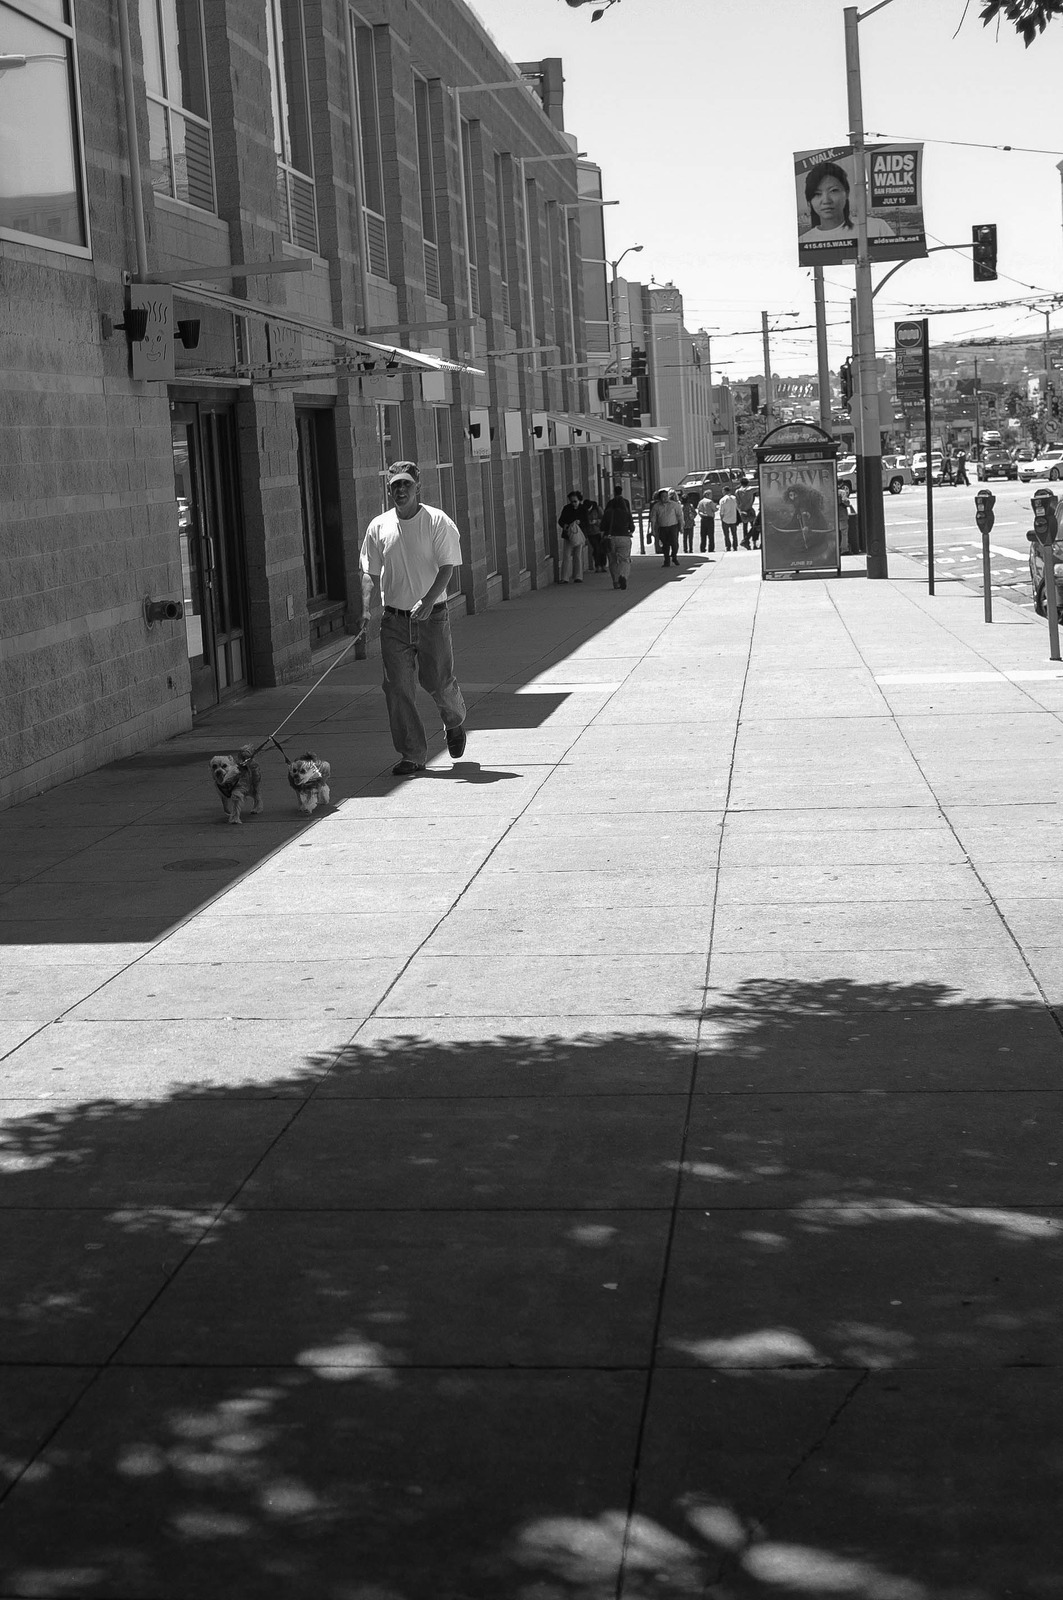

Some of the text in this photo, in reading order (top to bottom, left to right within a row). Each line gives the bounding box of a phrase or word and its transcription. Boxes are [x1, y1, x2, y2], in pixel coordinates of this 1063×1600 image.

[802, 160, 808, 169] I
[873, 154, 915, 172] AIDS
[874, 172, 914, 186] WALK
[885, 186, 914, 194] FRANCISCO
[803, 240, 853, 249] 415.615.WALK
[873, 236, 920, 245] aidswalk.net
[763, 469, 830, 488] BRAVE
